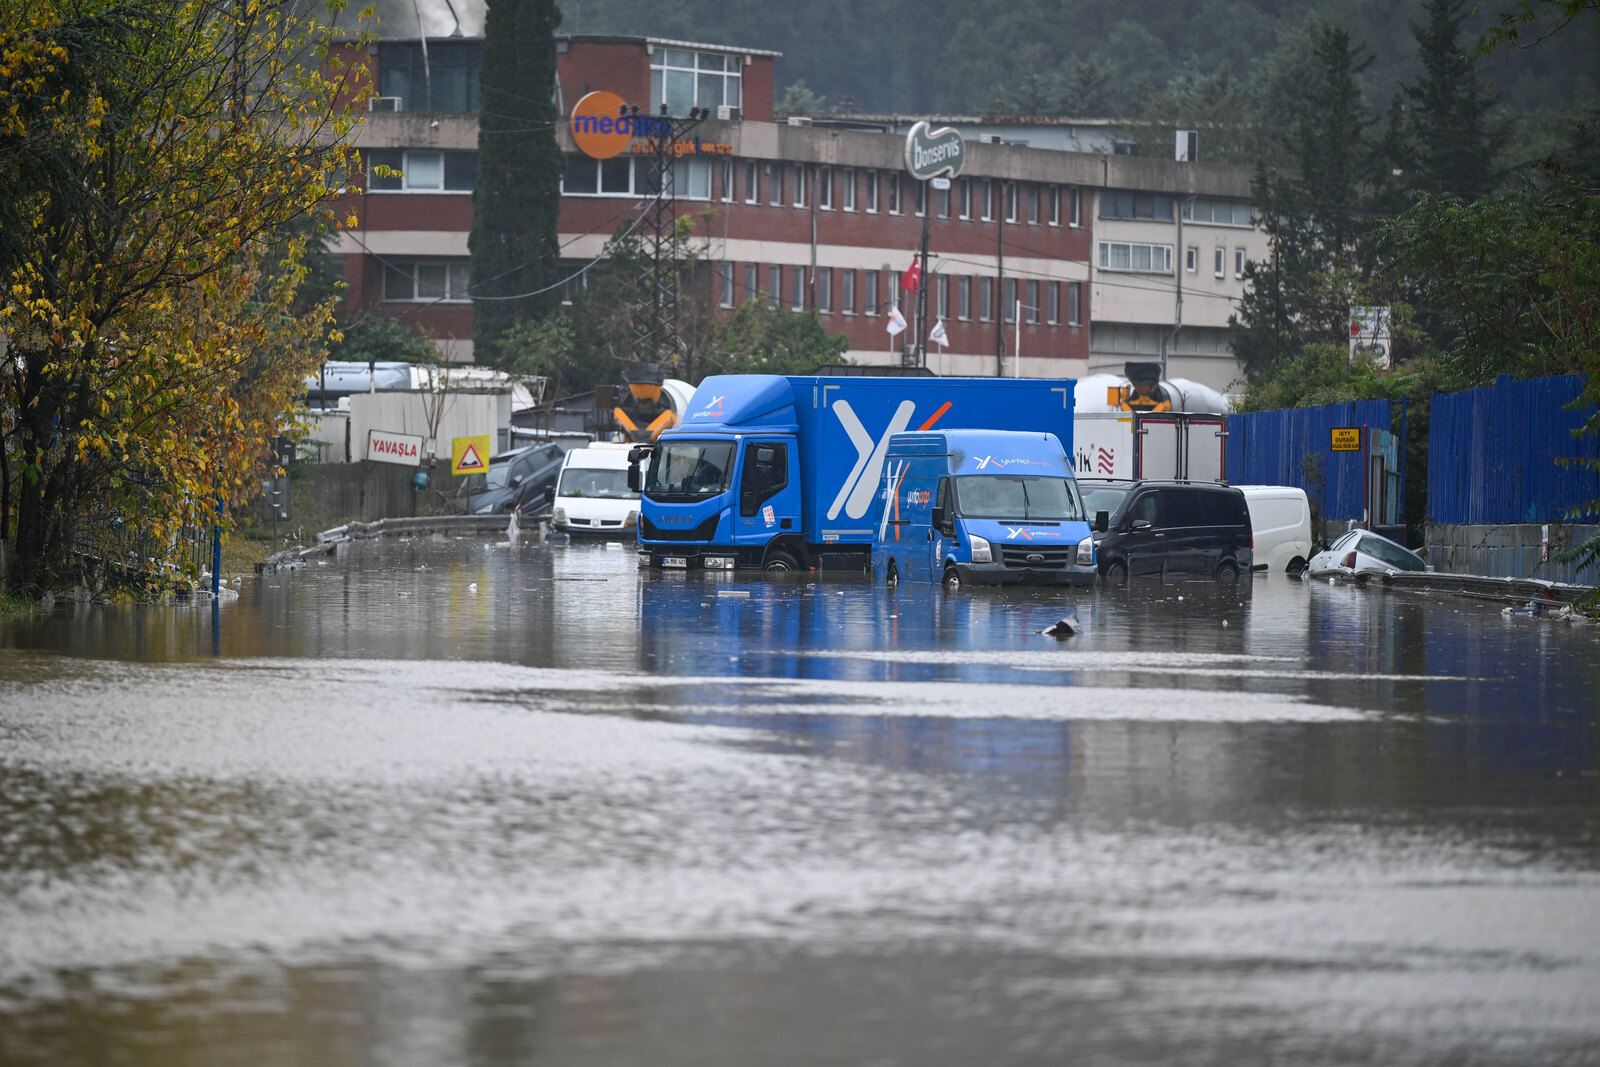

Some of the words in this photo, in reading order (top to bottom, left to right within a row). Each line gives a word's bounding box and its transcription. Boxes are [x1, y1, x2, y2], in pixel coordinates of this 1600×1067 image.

[914, 137, 960, 170] bonservis
[373, 439, 417, 457] YAVAŞLA
[658, 514, 692, 524] IVECO
